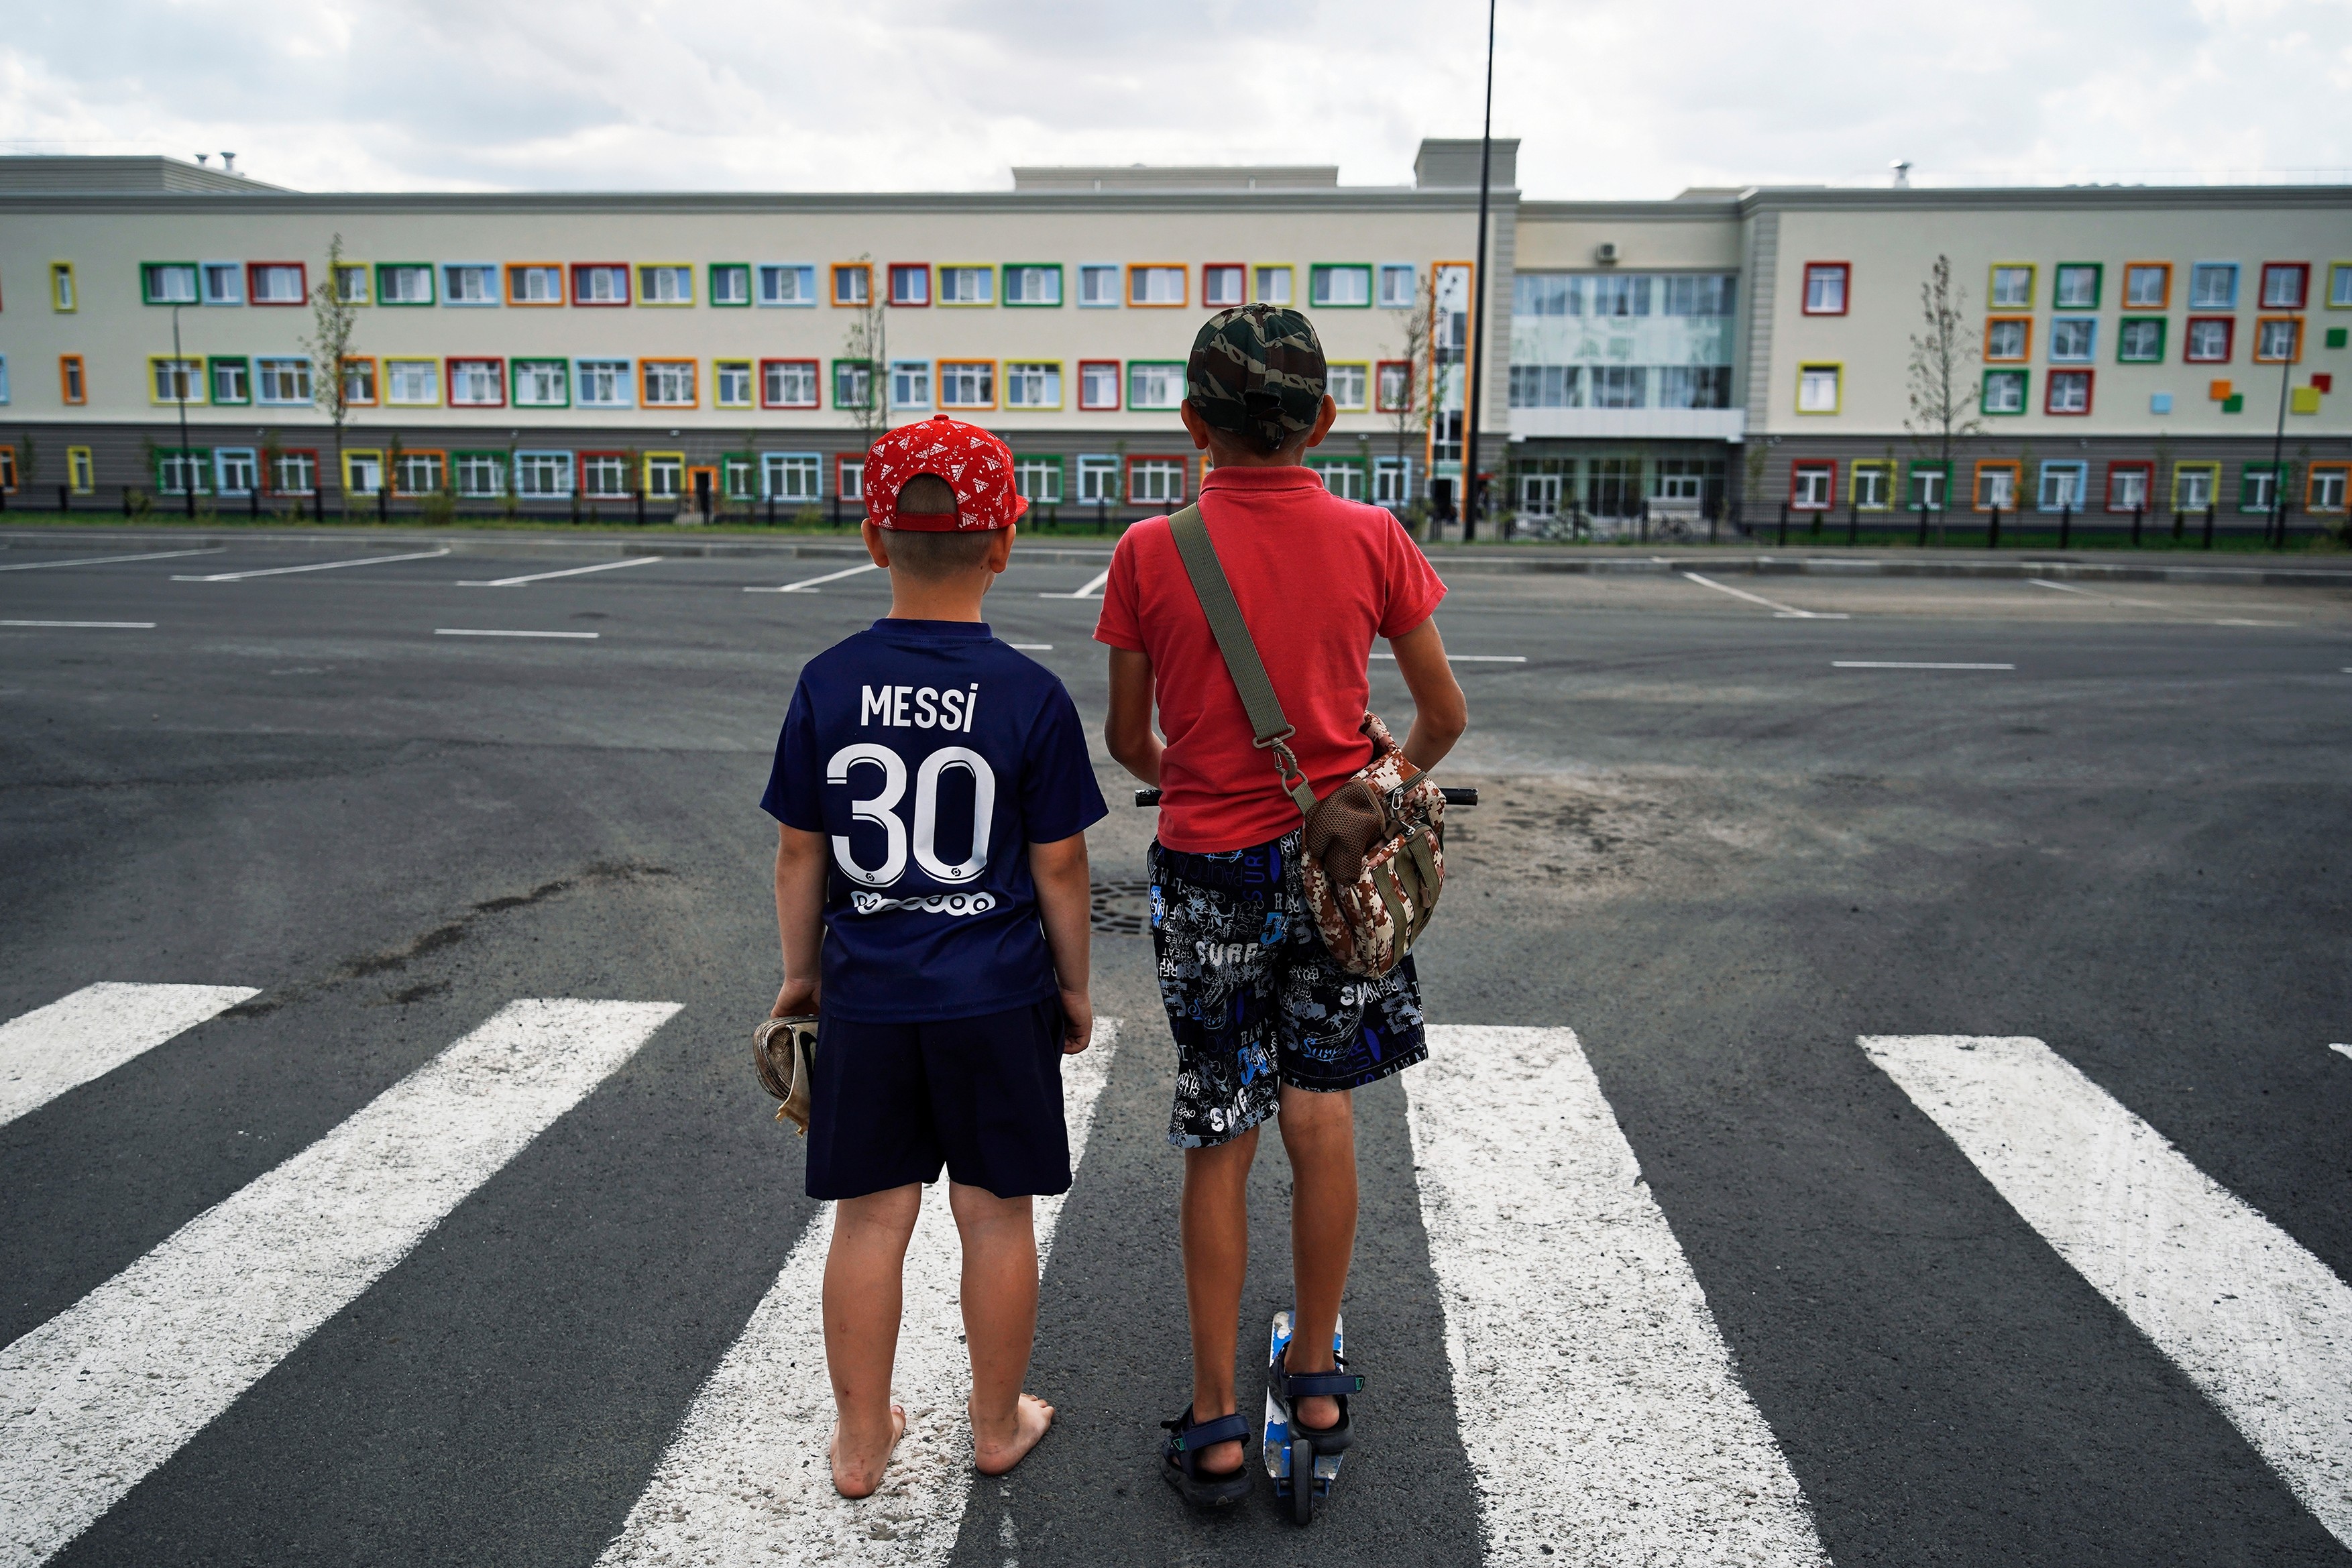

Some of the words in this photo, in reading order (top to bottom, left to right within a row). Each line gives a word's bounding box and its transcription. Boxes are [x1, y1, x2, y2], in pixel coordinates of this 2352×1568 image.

[930, 446, 948, 455] adidas
[827, 743, 995, 888] 30
[1242, 846, 1266, 901] SUR
[1195, 941, 1259, 966] SURF
[1210, 1087, 1247, 1132] SUF
